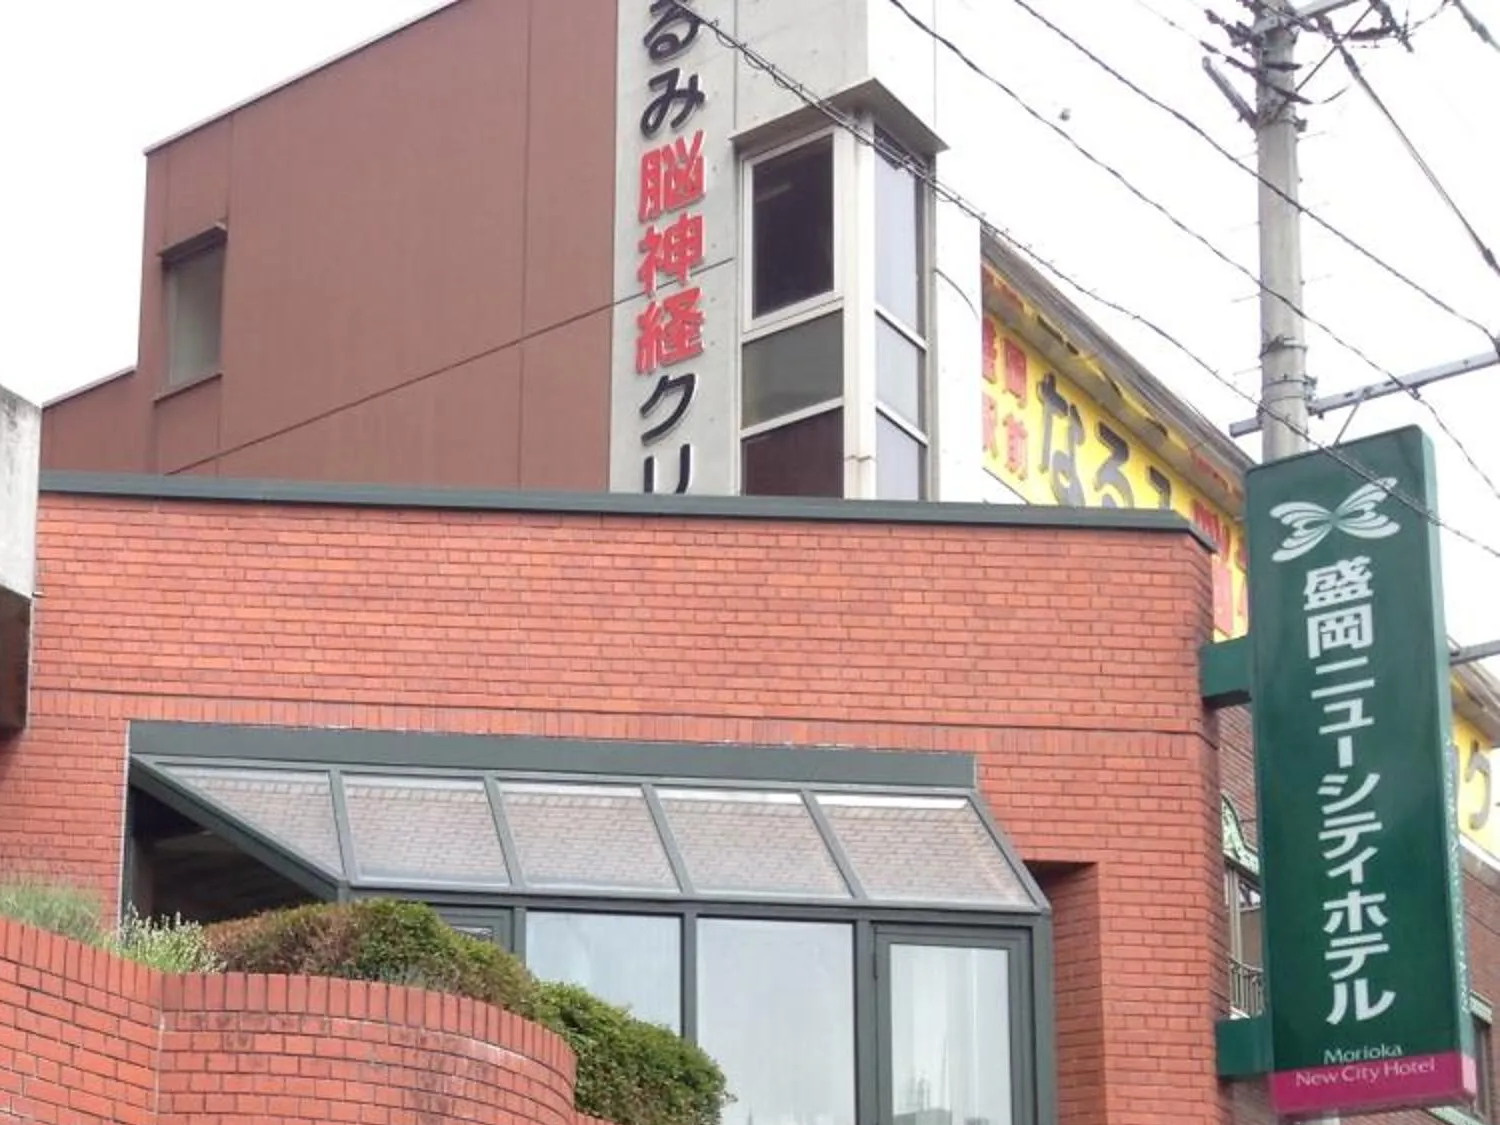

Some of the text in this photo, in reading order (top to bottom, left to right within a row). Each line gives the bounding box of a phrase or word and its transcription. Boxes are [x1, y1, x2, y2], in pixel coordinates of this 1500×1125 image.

[1303, 555, 1396, 1026] 盛岡ニューシティホテル
[1323, 1043, 1403, 1065] Morioka
[1296, 1058, 1436, 1087] New City Hotel
